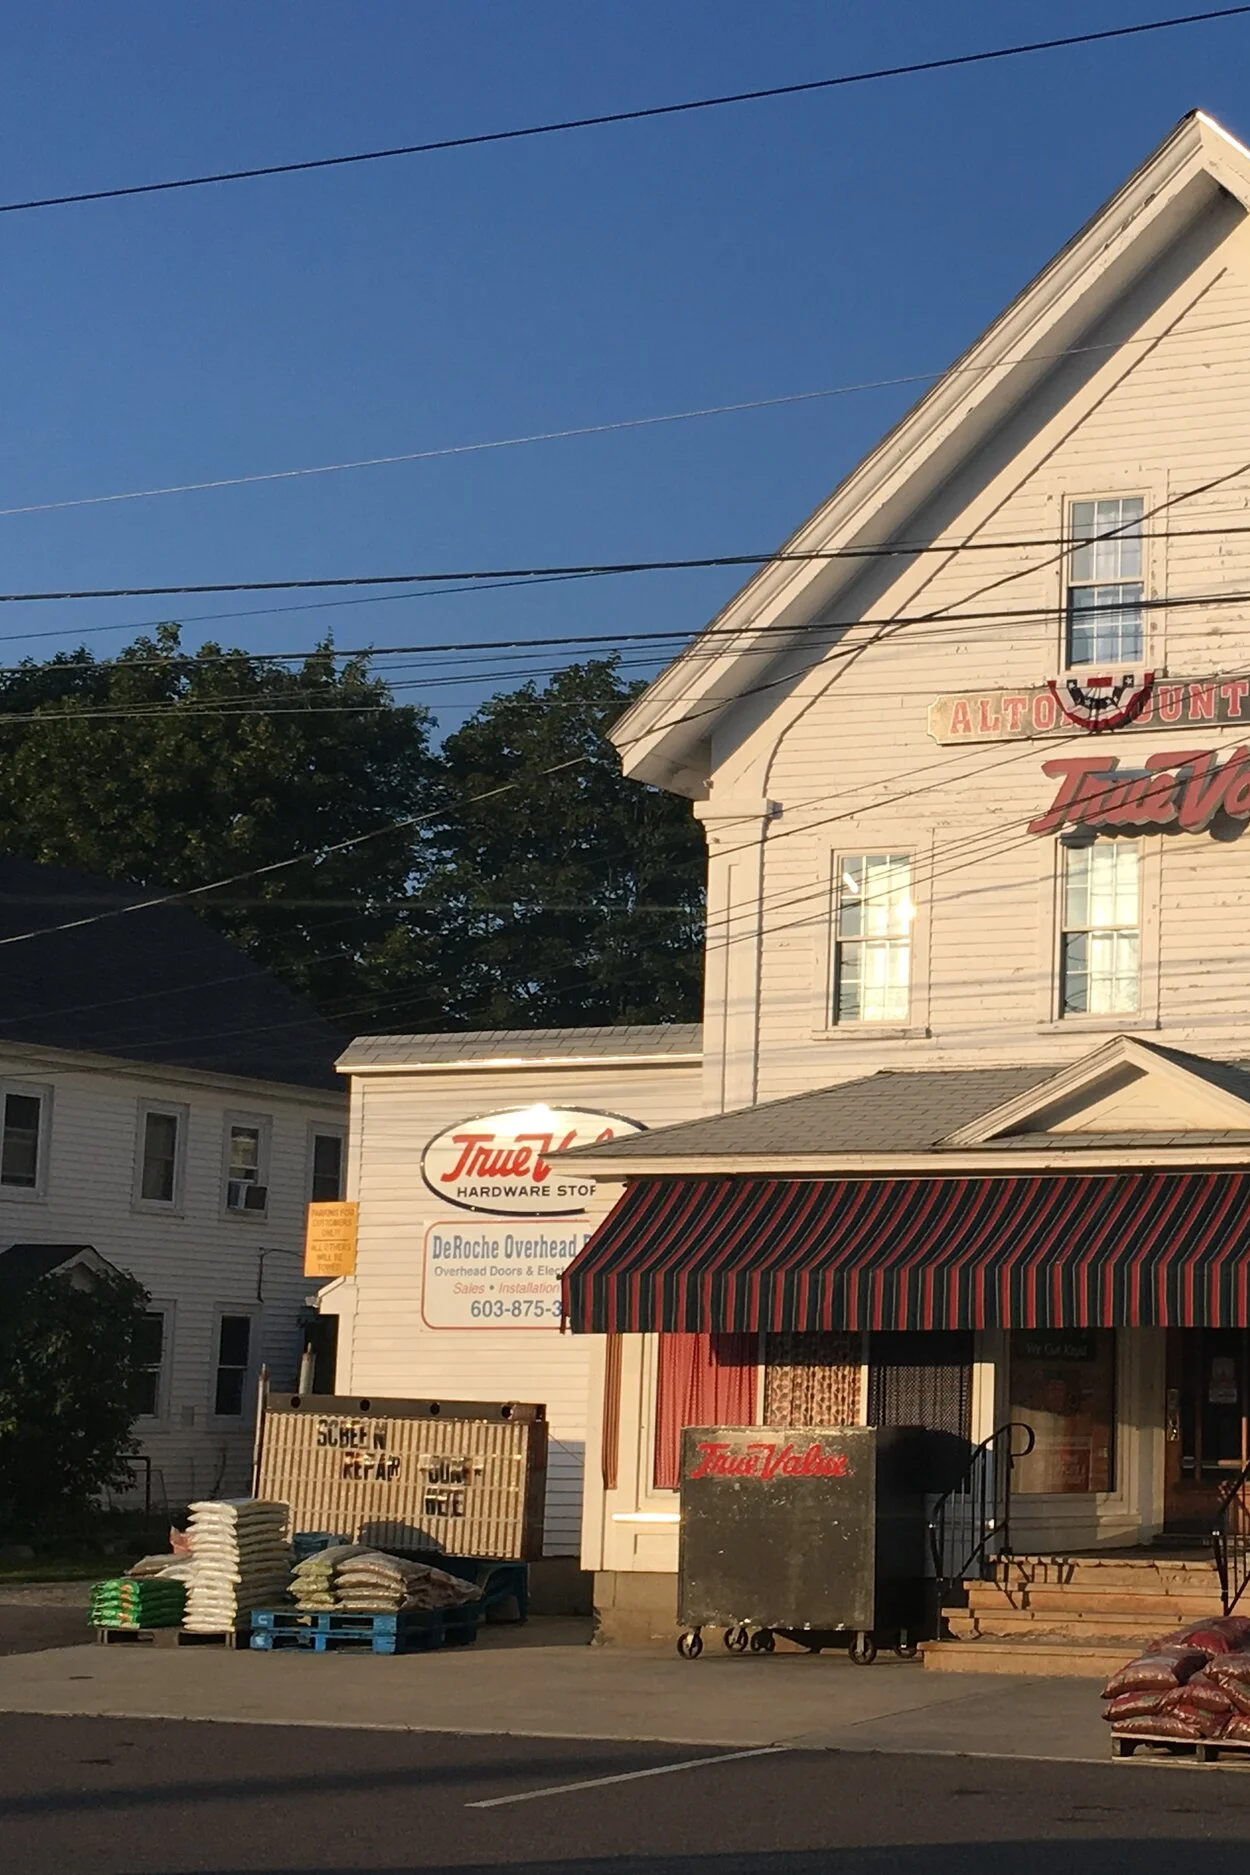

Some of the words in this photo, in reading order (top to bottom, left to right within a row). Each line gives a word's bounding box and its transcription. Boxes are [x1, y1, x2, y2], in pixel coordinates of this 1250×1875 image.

[440, 1133, 534, 1182] True
[457, 1185, 550, 1198] HARDWARE
[557, 1184, 596, 1197] STO
[432, 1235, 500, 1260] DeRoche
[504, 1233, 577, 1259] Overhead
[434, 1266, 487, 1277] Overhead
[489, 1266, 523, 1276] Doors
[526, 1266, 534, 1276] &
[537, 1265, 565, 1276] Elect
[453, 1282, 485, 1294] Sales
[498, 1281, 560, 1294] Installation
[471, 1300, 563, 1318] 603-875-3
[316, 1419, 387, 1450] SCREEN
